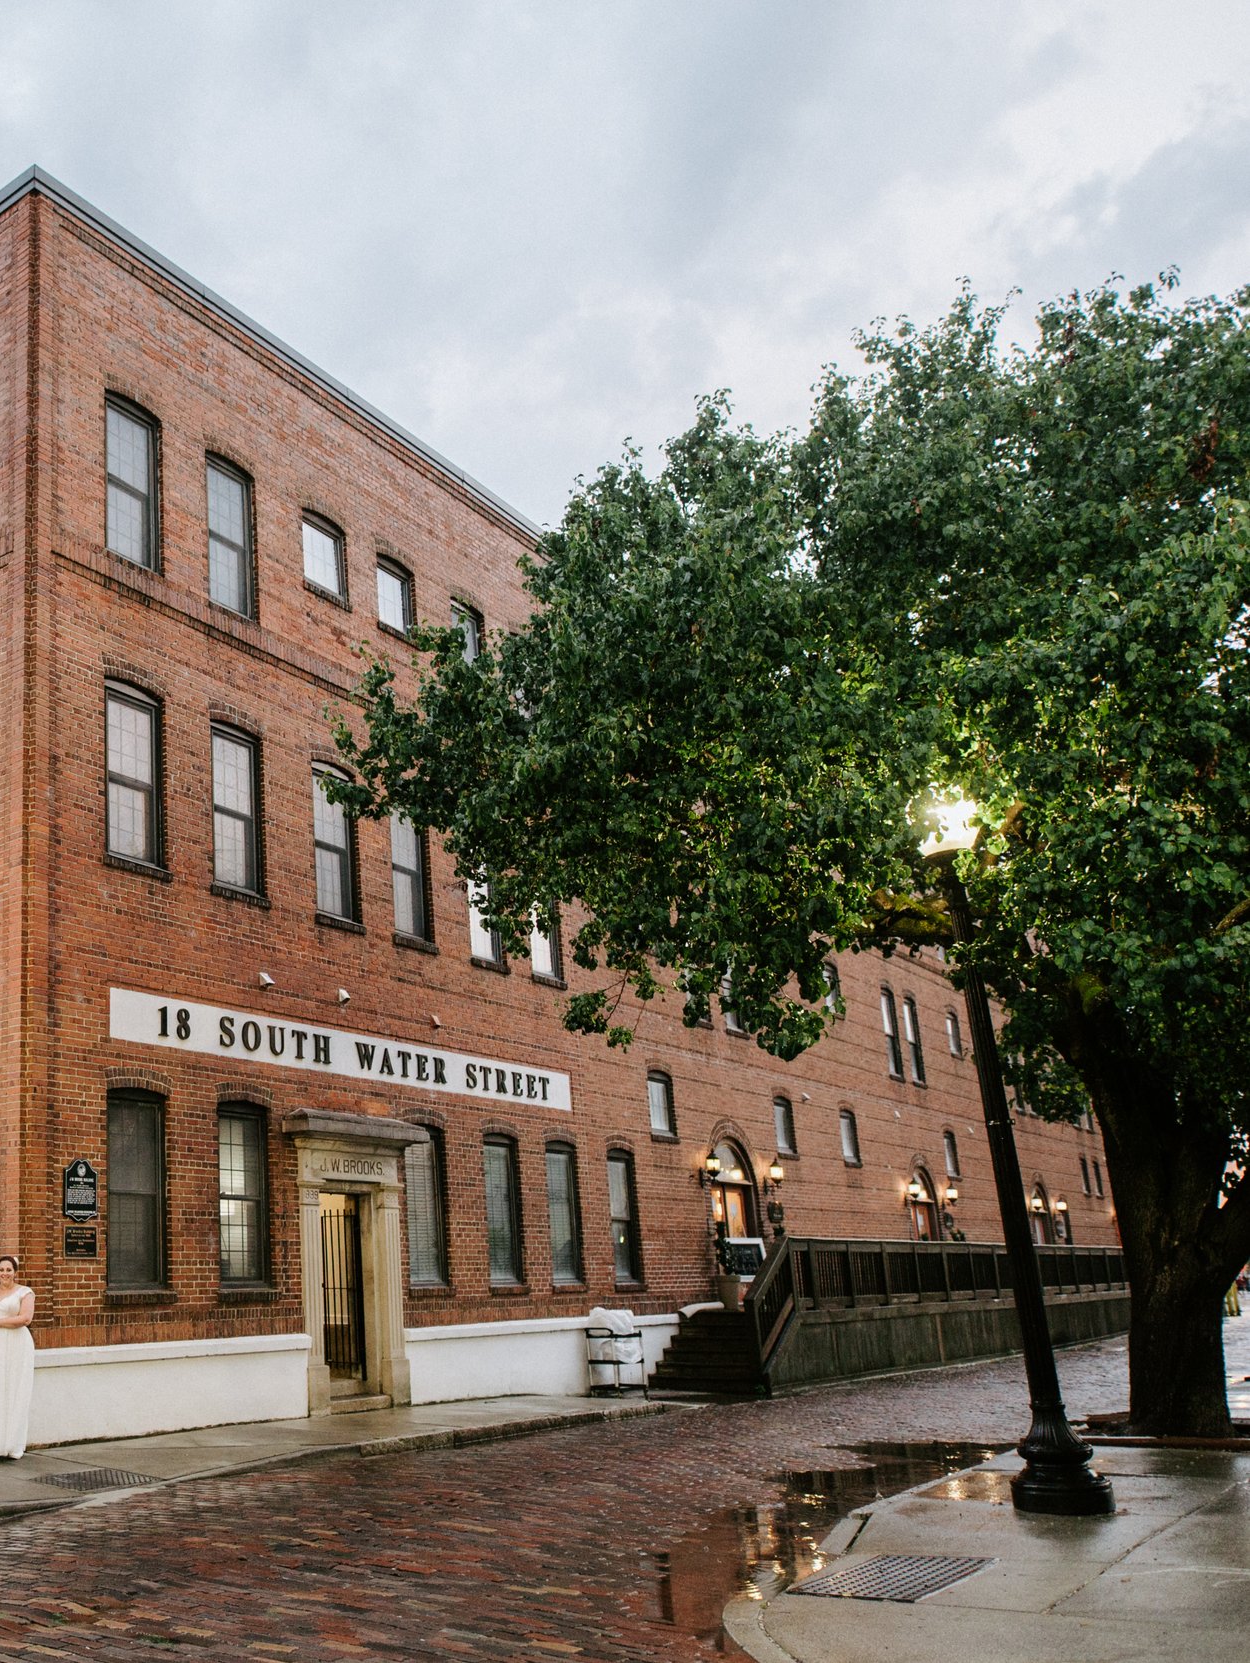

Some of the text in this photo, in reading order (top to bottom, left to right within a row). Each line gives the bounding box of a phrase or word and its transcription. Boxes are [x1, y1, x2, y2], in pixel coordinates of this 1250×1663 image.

[157, 1006, 550, 1101] 18 SOUTH WATER STREET
